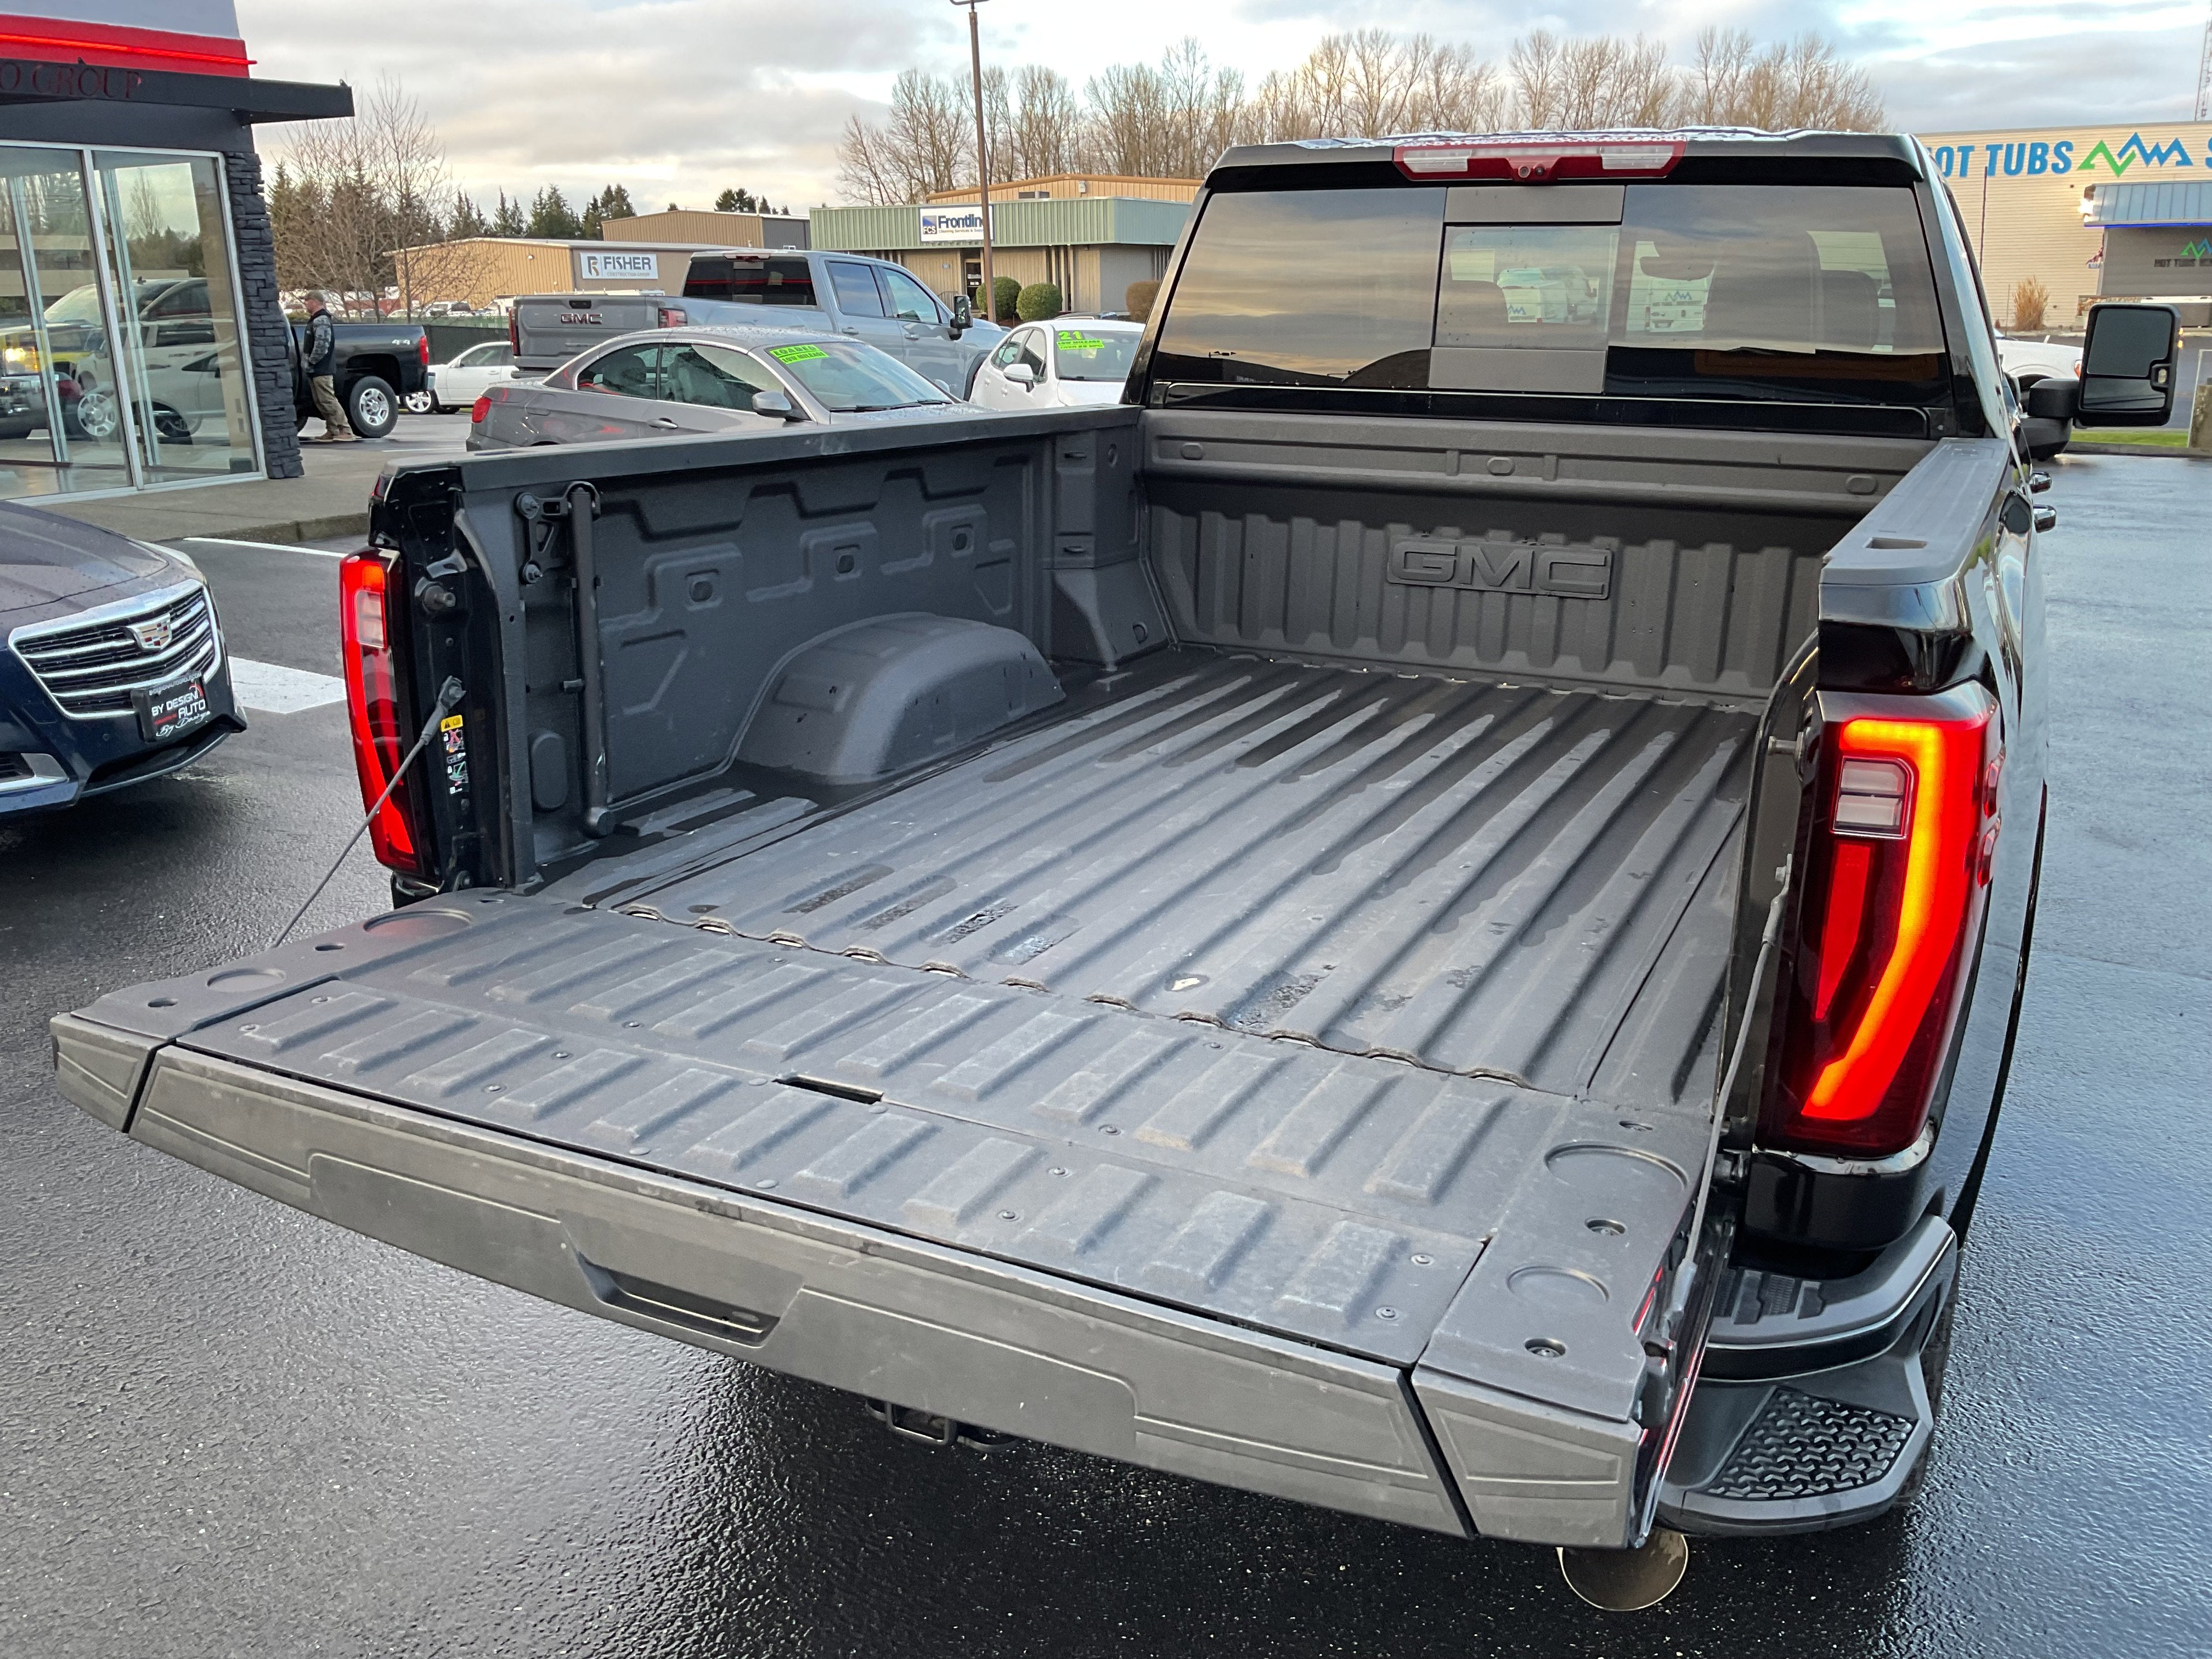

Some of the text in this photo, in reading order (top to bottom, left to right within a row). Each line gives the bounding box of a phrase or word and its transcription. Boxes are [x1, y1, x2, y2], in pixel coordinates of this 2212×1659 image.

[32, 64, 142, 99] GROUP
[1927, 140, 2074, 178] OT TUBS
[938, 214, 983, 228] Frontlin
[923, 225, 936, 234] FCS
[603, 256, 651, 270] FISHER
[561, 313, 603, 325] GMC
[1058, 331, 1082, 340] 21
[773, 346, 816, 356] LOADED
[1391, 541, 1607, 595] GMC
[151, 690, 199, 716] BY DESIGN
[178, 699, 206, 719] AUTO
